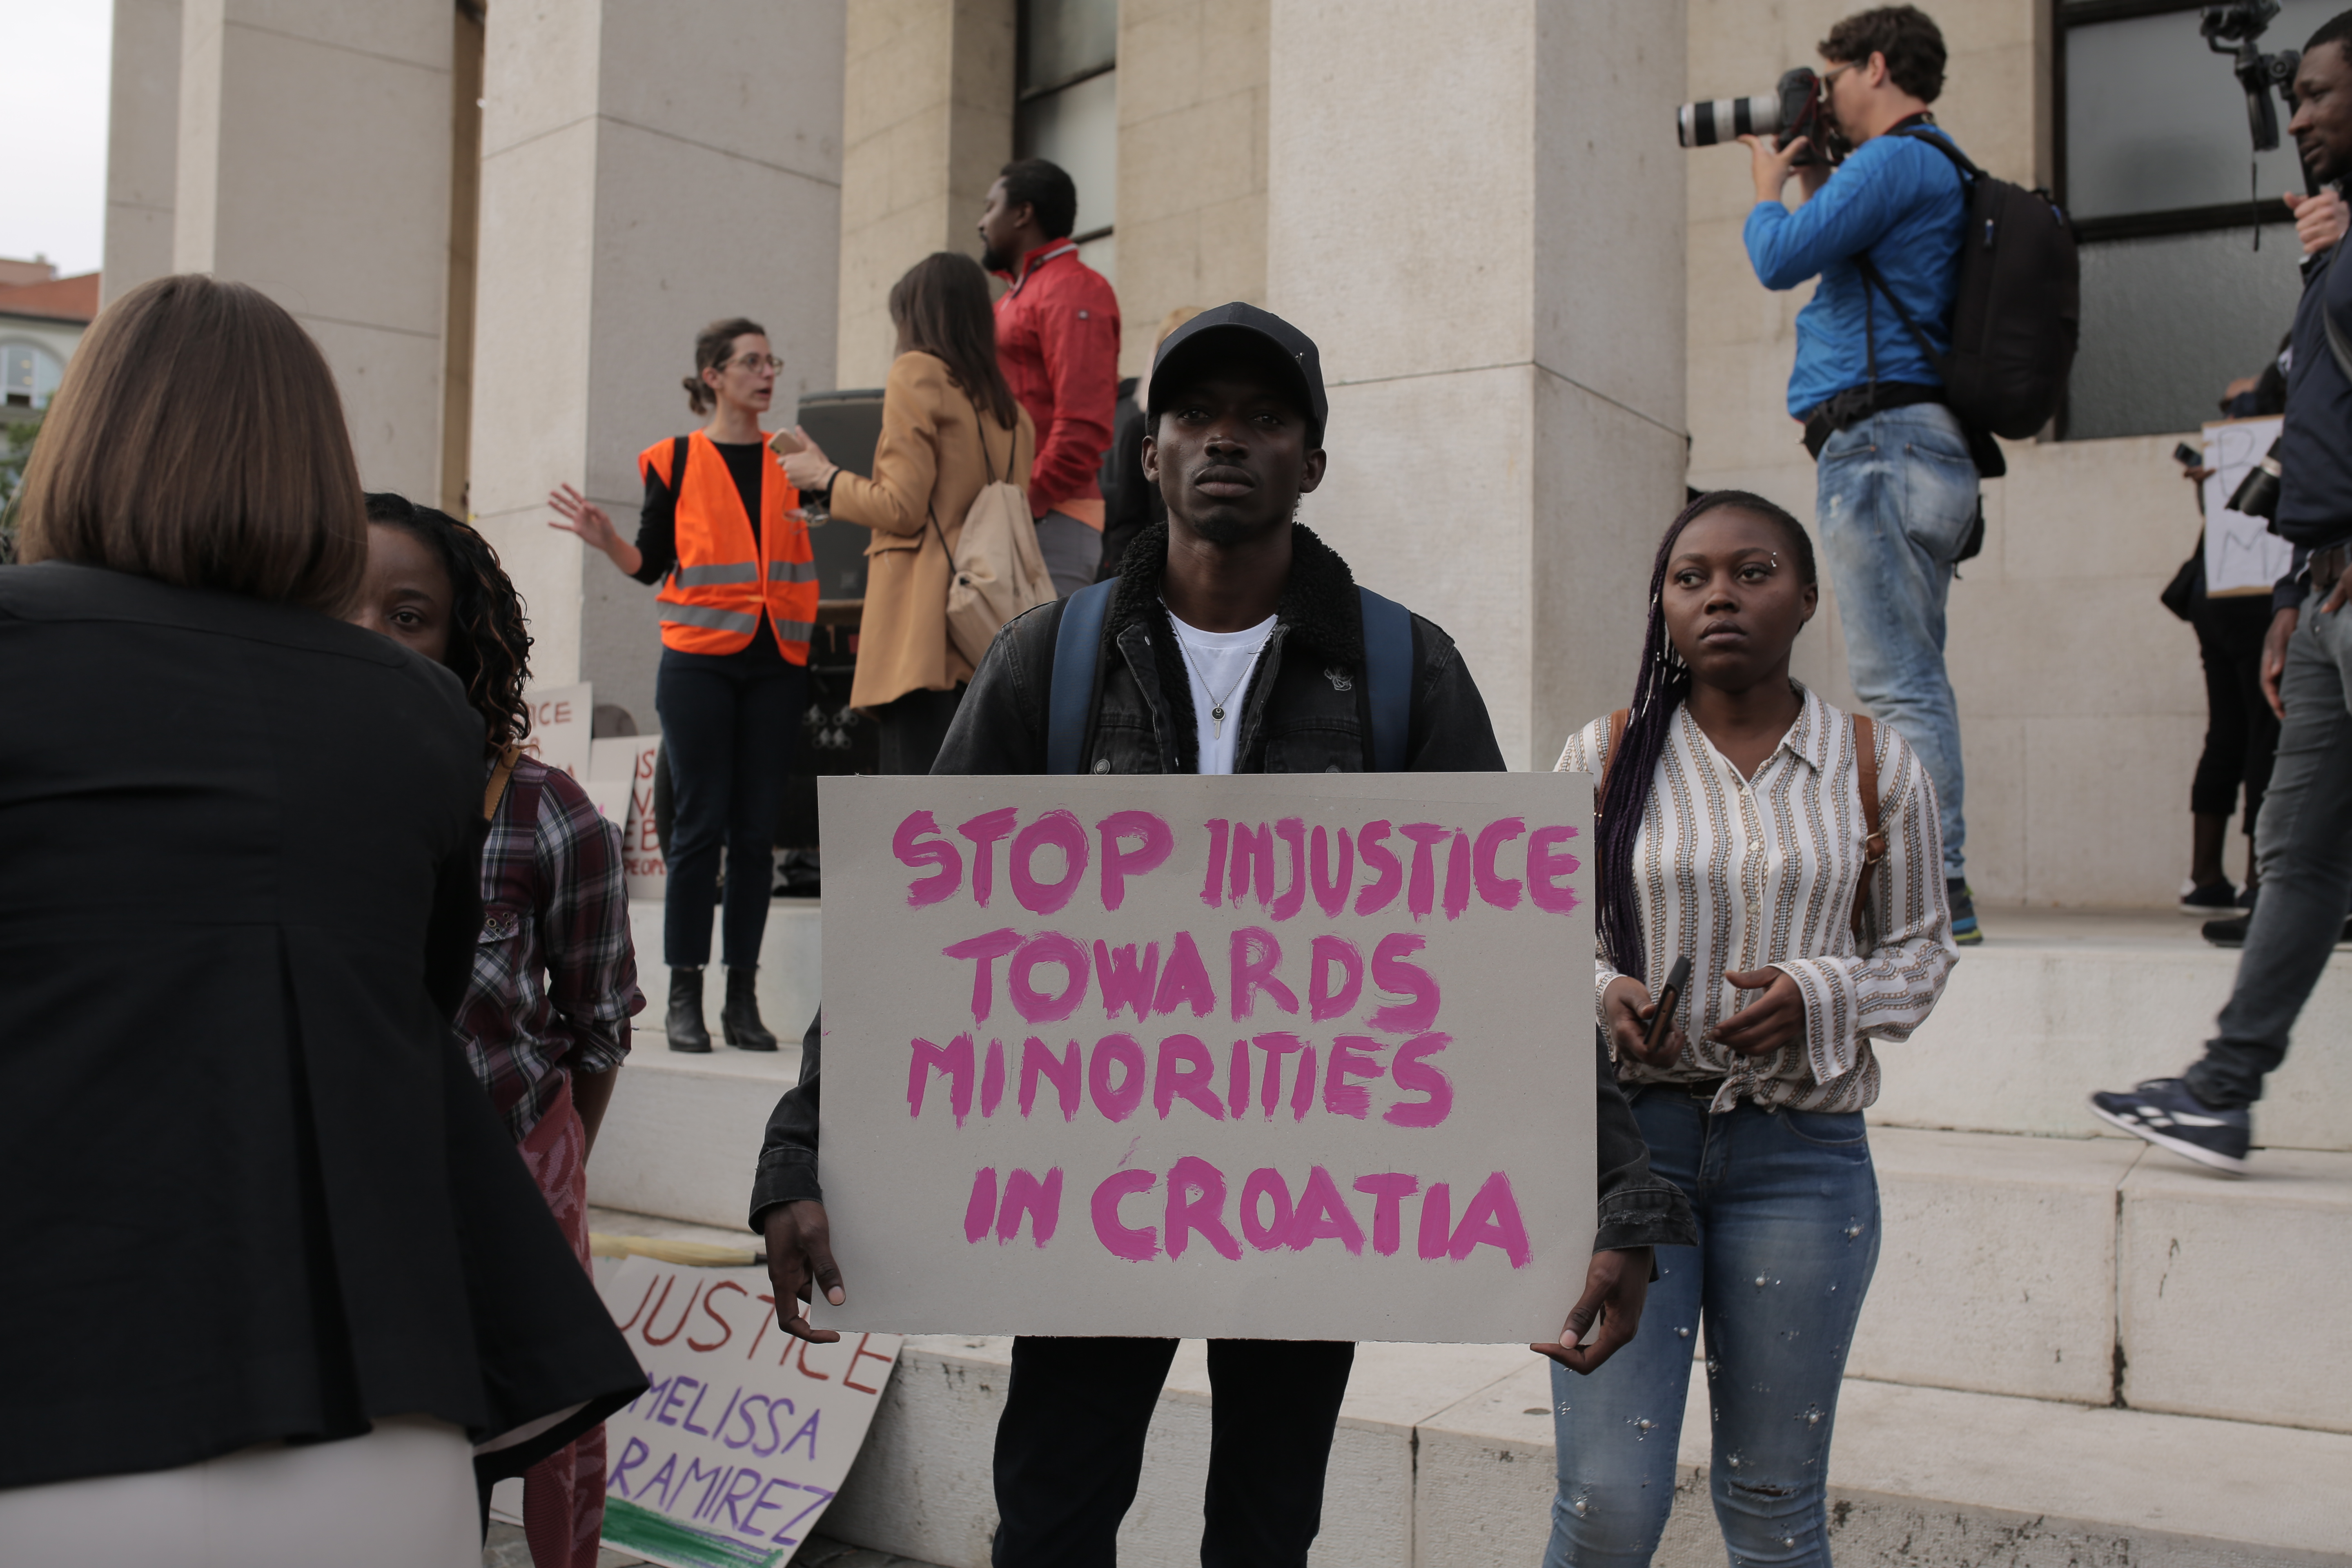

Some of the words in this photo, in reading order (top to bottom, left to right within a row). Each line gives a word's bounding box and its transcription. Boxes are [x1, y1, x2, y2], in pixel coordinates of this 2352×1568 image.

[892, 806, 1175, 917] STOP
[1199, 817, 1583, 923] INJUSTICE
[942, 925, 1441, 1033] TOWARDS
[906, 1029, 1454, 1130] MINORITIES
[963, 1165, 1064, 1250] IN
[1090, 1156, 1534, 1269] CROATIA
[628, 1372, 820, 1461] MELISSA
[606, 1436, 837, 1546] RAMIREZ
